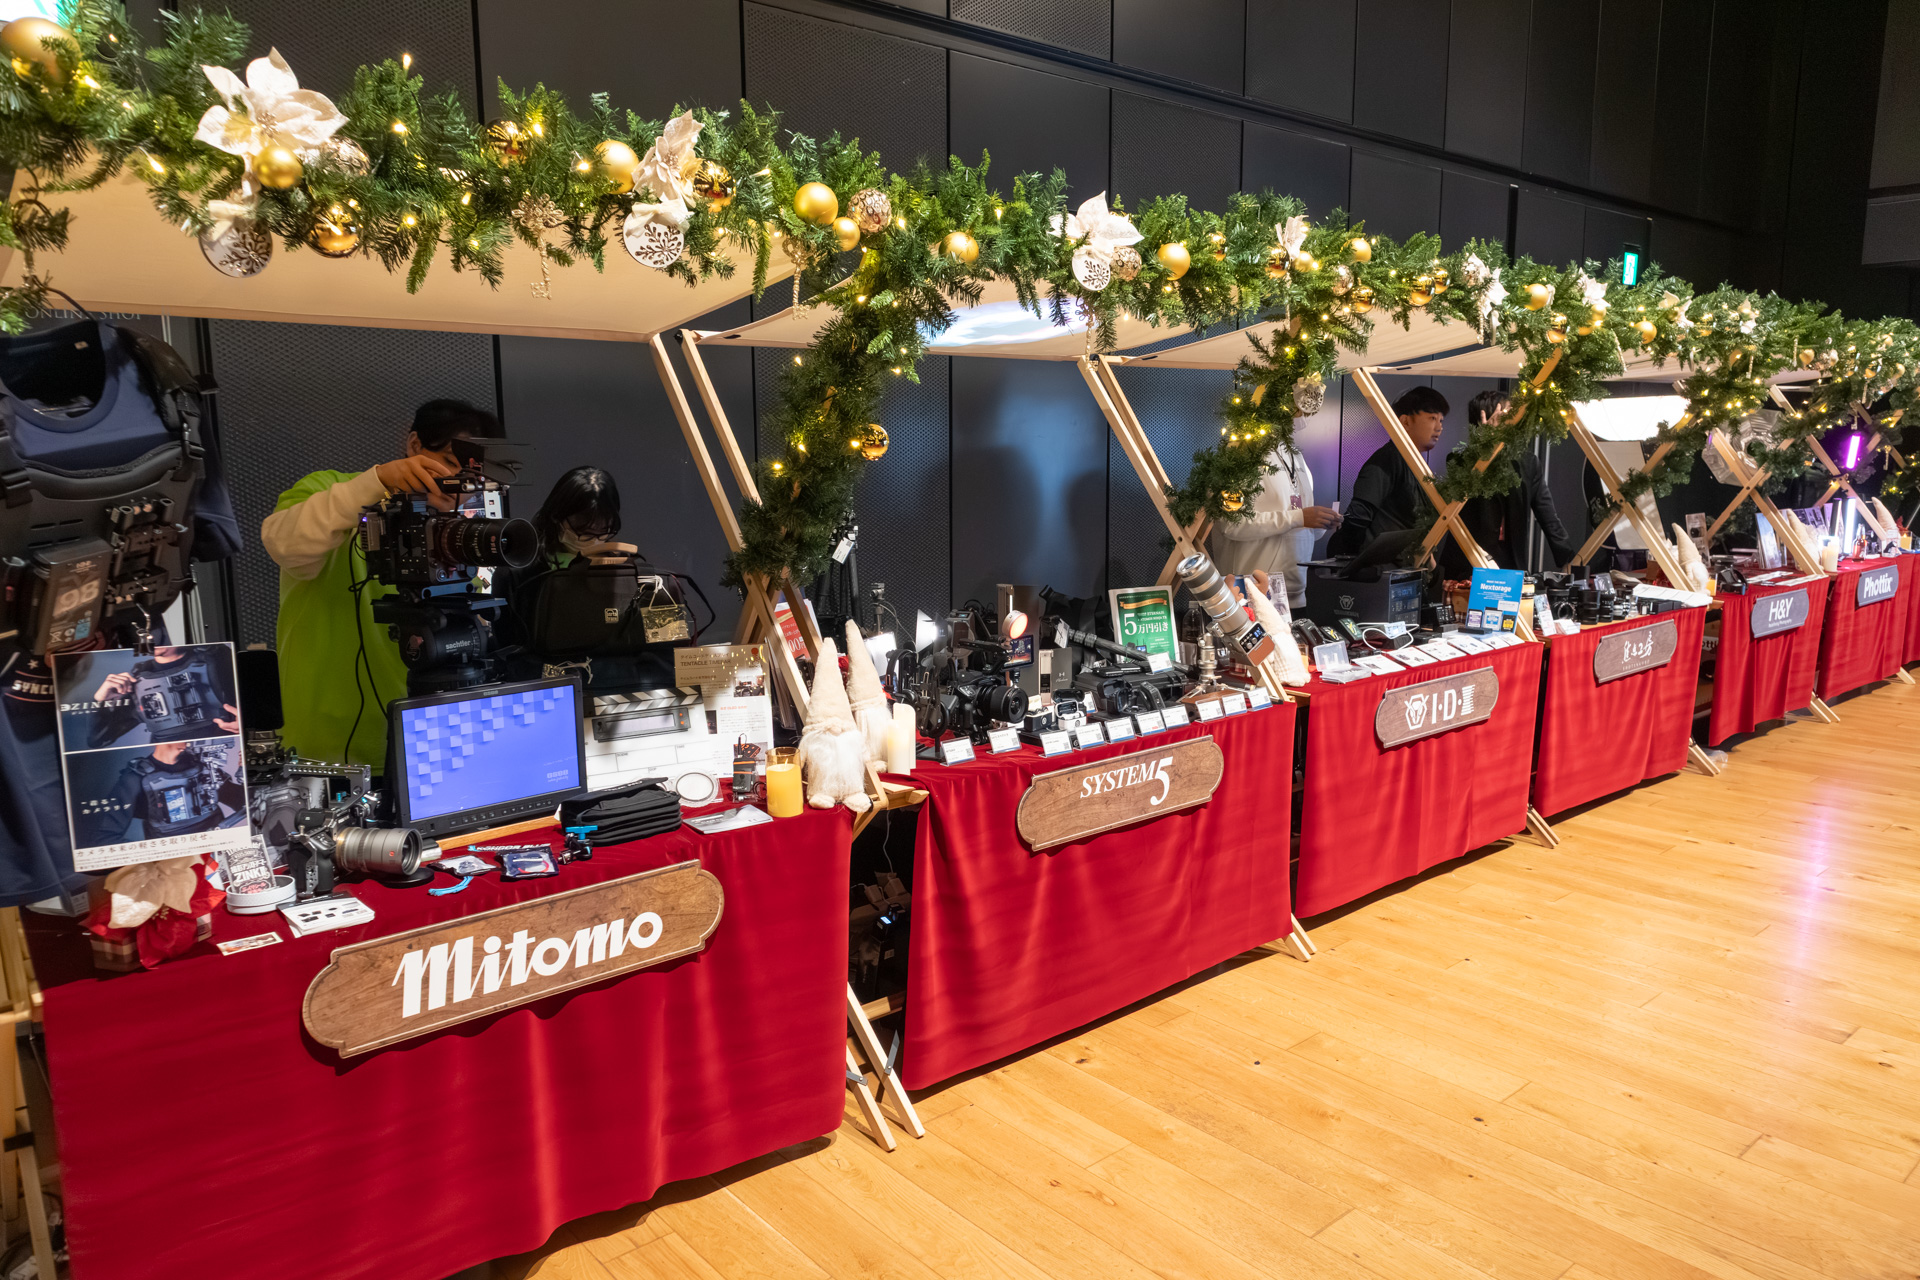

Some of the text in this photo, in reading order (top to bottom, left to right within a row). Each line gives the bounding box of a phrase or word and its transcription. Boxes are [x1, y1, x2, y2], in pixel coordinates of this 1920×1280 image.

[1480, 583, 1512, 593] Nextorage
[1863, 573, 1893, 599] Phottix
[1768, 597, 1794, 622] H&Y
[1124, 612, 1168, 636] 5万円引き
[445, 640, 471, 650] sachtler
